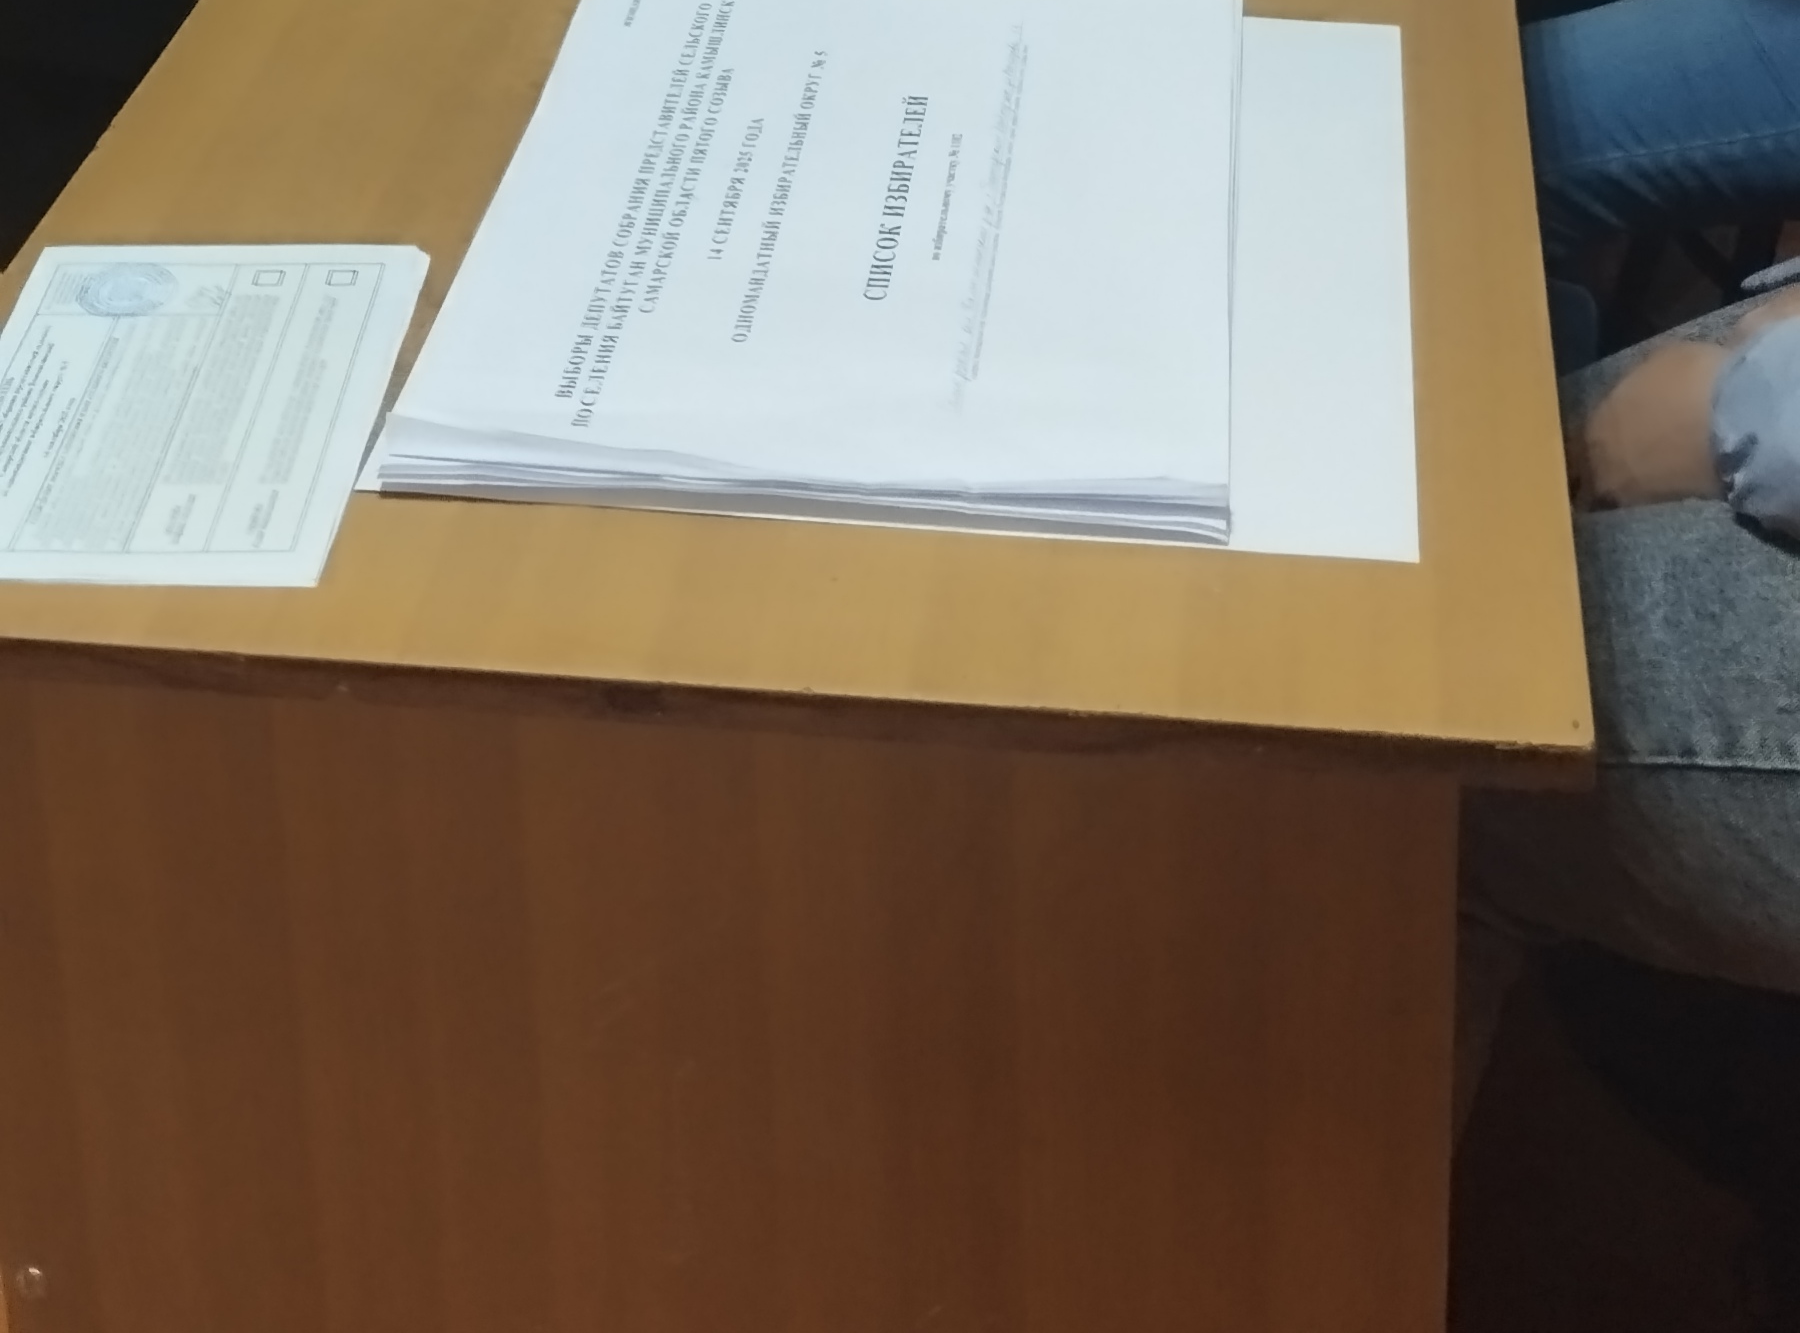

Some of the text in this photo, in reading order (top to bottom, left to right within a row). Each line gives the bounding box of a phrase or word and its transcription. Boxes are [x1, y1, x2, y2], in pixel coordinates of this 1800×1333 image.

[799, 72, 823, 110] ОКРУГ
[810, 58, 827, 70] №
[554, 2, 713, 399] ВЫБОРЫ ДЕПУТАТОВ СОБРАНИЯ ПРЕДСТАВИТЕЛЕЙ СЕЛЬСКОГО
[638, 67, 735, 314] САМАРСКОЙ ОБЛАСТИ ПЯТОГО СОЗЫВА
[706, 118, 764, 261] 14 СЕНТЯБРЯ 2025 ГОДА
[768, 112, 813, 217] ИЗБИРАТЕЛЬНЫЙ
[862, 95, 930, 301] СПИСОК ИЗБИРАТЕЛЕЙ
[570, 334, 620, 429] ПОСЕЛЕНИЯ
[605, 260, 648, 331] БАЙТУГАН
[633, 133, 690, 256] МУНИЦИПАЛЬНОГО
[678, 83, 708, 131] РАЙОНА
[730, 220, 782, 343] ОДНОМАНДАТНЫЙ
